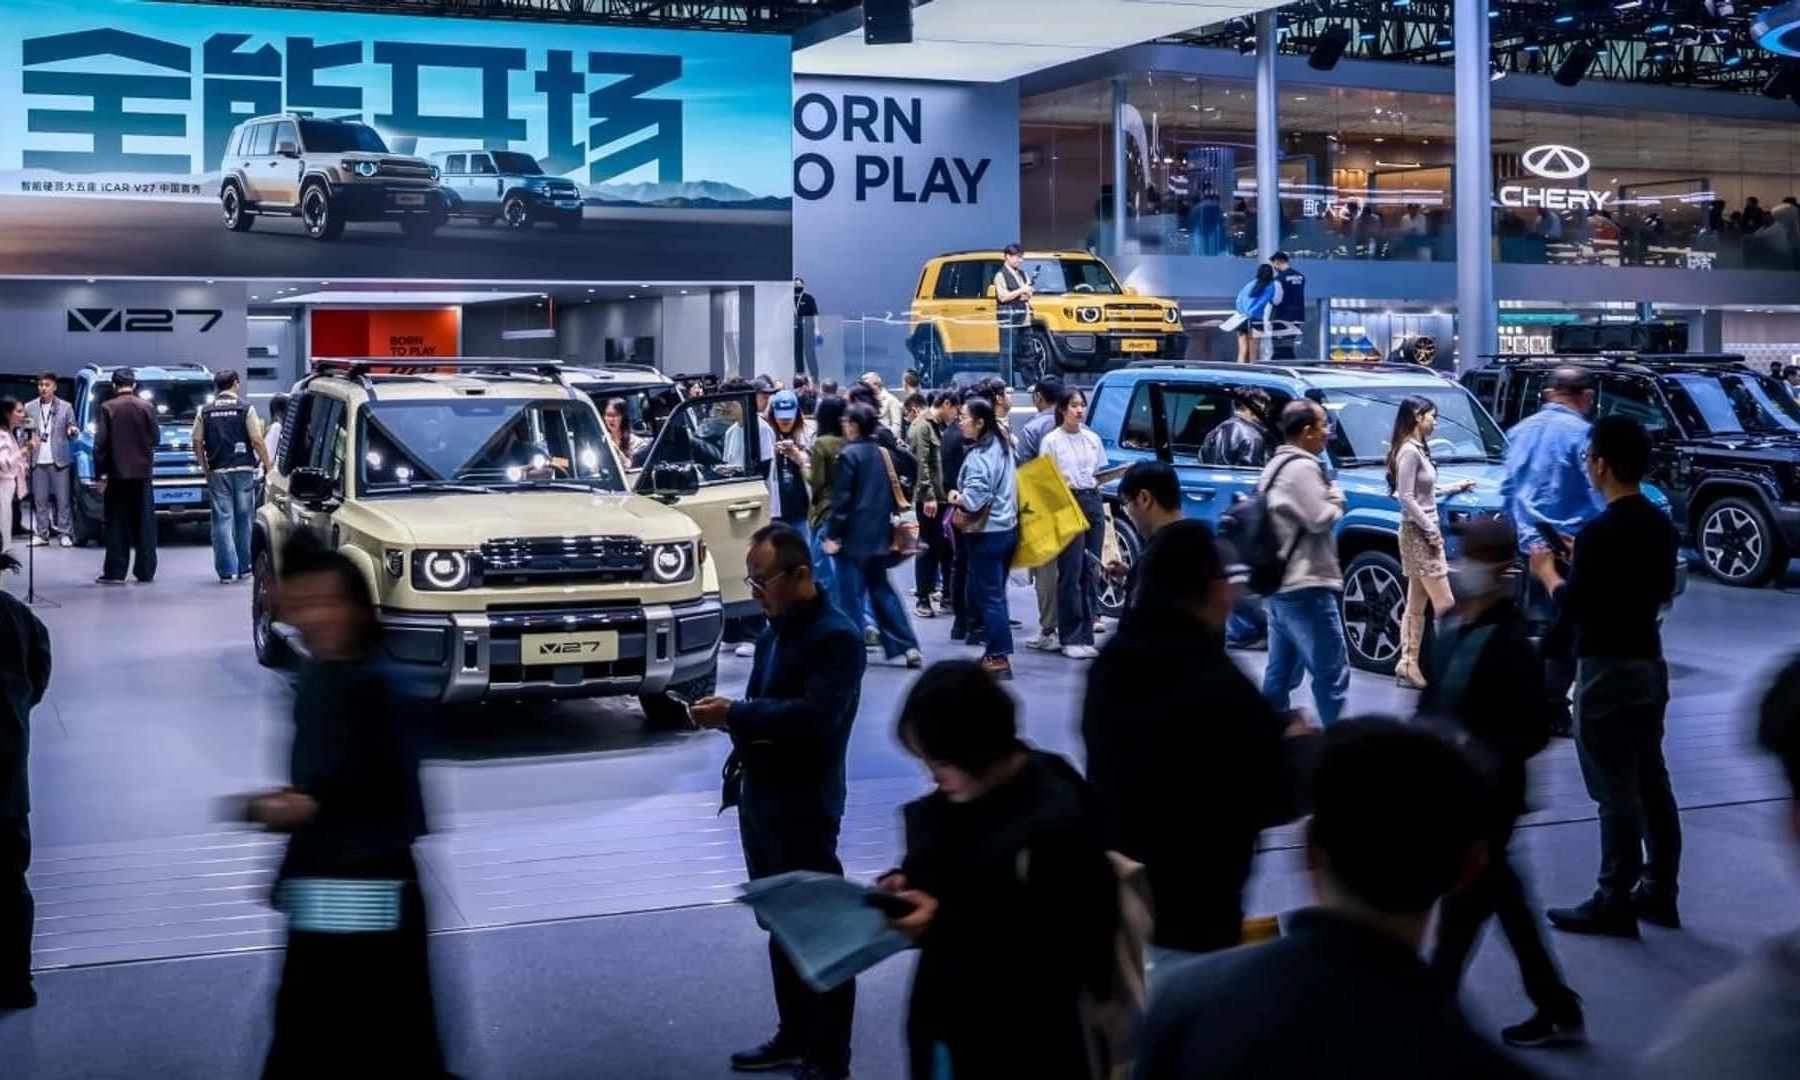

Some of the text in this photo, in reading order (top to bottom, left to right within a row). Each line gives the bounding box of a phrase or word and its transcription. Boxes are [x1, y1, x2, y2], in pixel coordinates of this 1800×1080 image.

[22, 27, 683, 186] 全能开场
[793, 92, 922, 145] ORN
[101, 182, 130, 192] iCAR
[134, 182, 155, 193] V27
[793, 152, 992, 205] O PLAY
[1500, 185, 1611, 211] CHERY
[67, 307, 224, 333] V27
[389, 335, 424, 346] BORN
[390, 346, 437, 356] TO PLAY
[540, 641, 600, 655] V27
